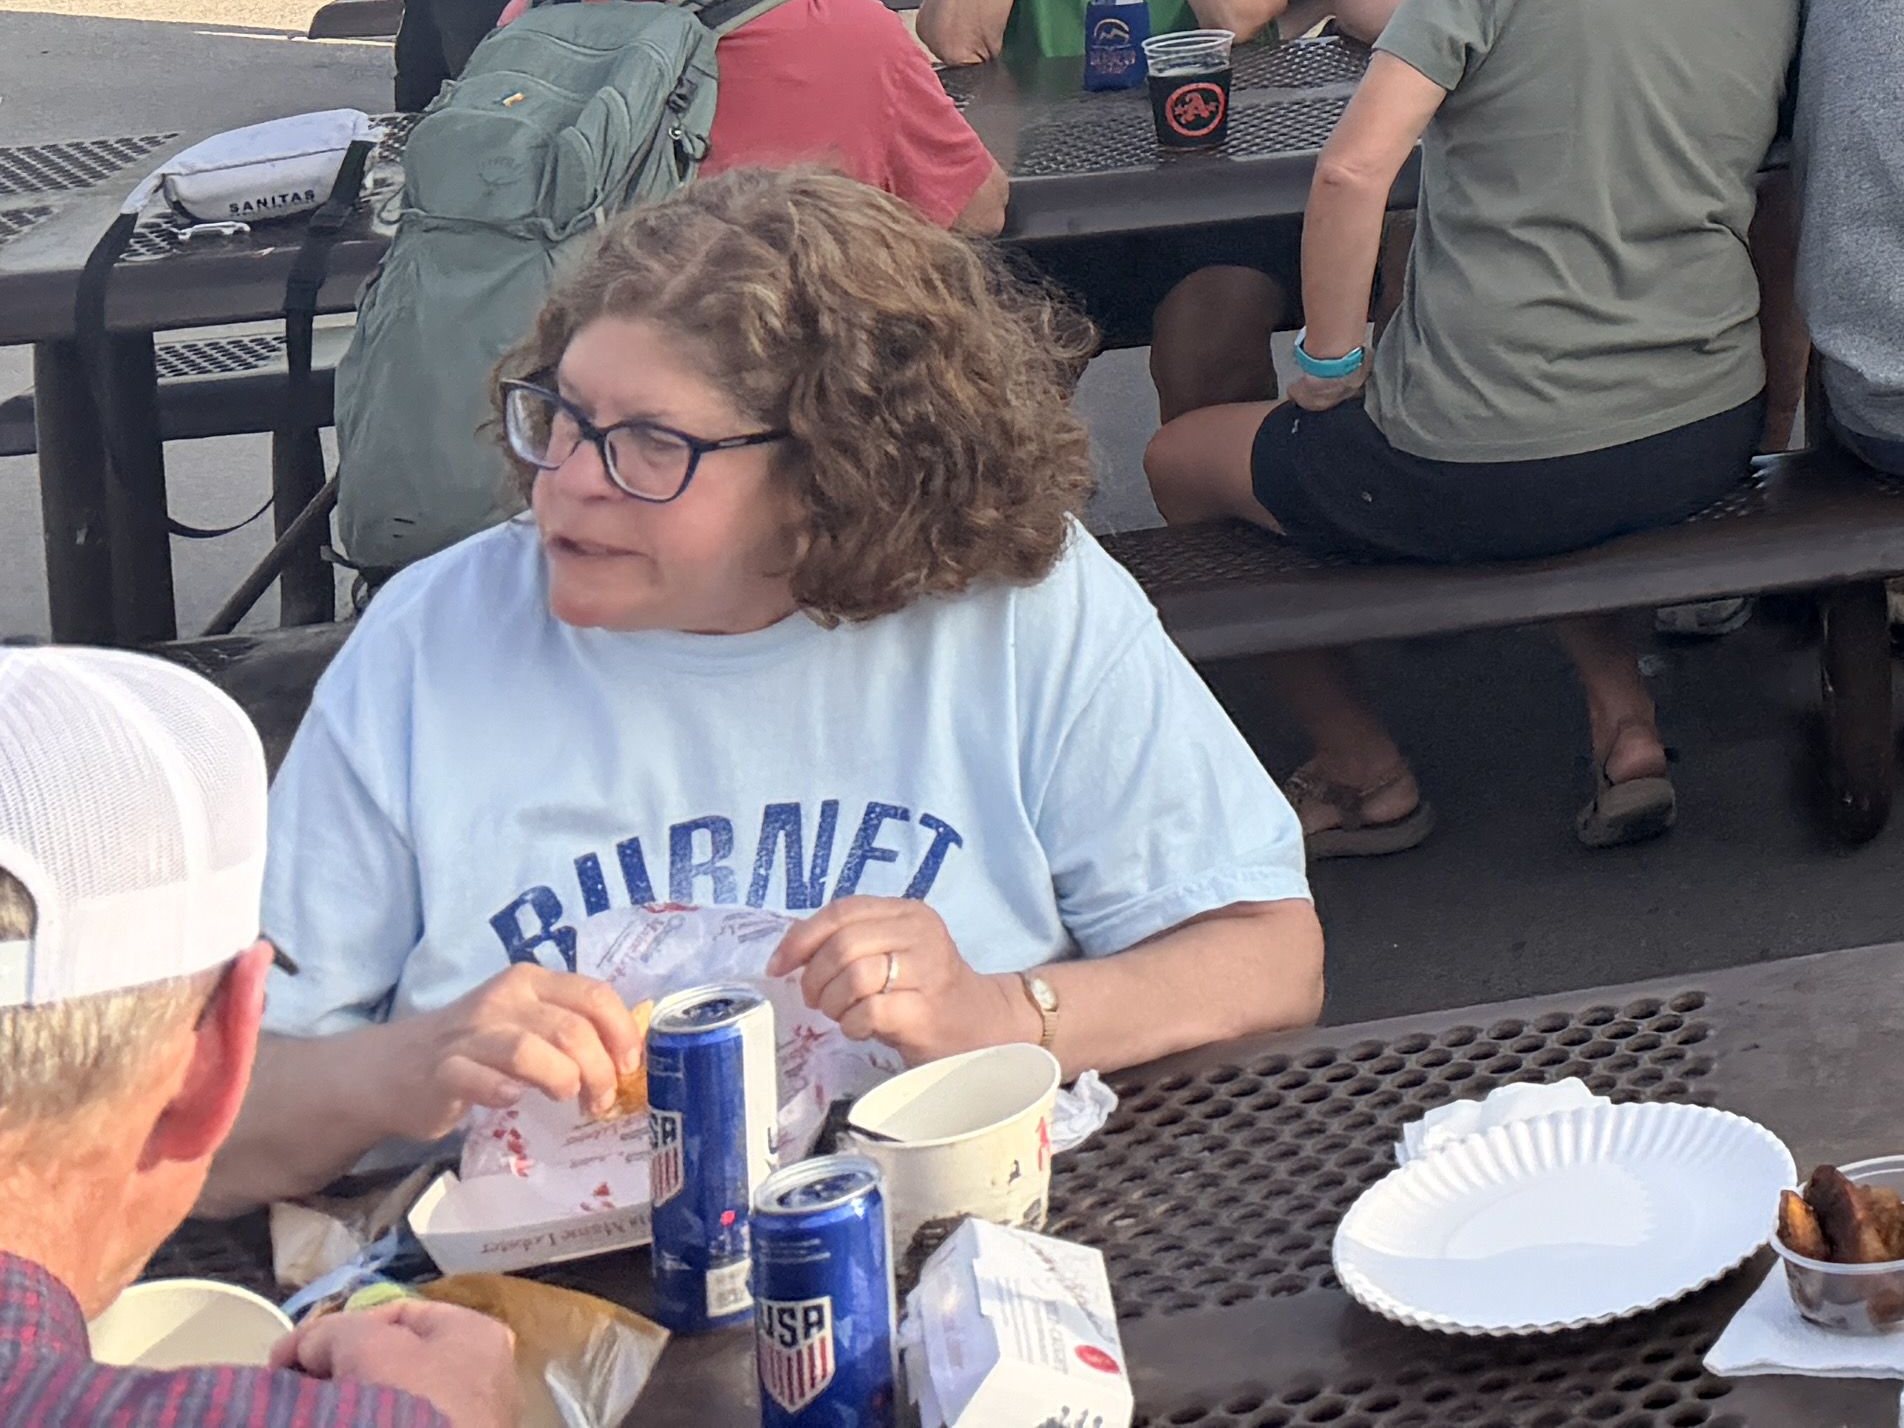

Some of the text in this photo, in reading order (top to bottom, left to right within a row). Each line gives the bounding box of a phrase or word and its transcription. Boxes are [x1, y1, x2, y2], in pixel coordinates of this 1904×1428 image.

[228, 189, 316, 214] SANITAS
[488, 799, 964, 974] BURNET
[650, 1112, 677, 1146] SA
[758, 1302, 827, 1349] USA
